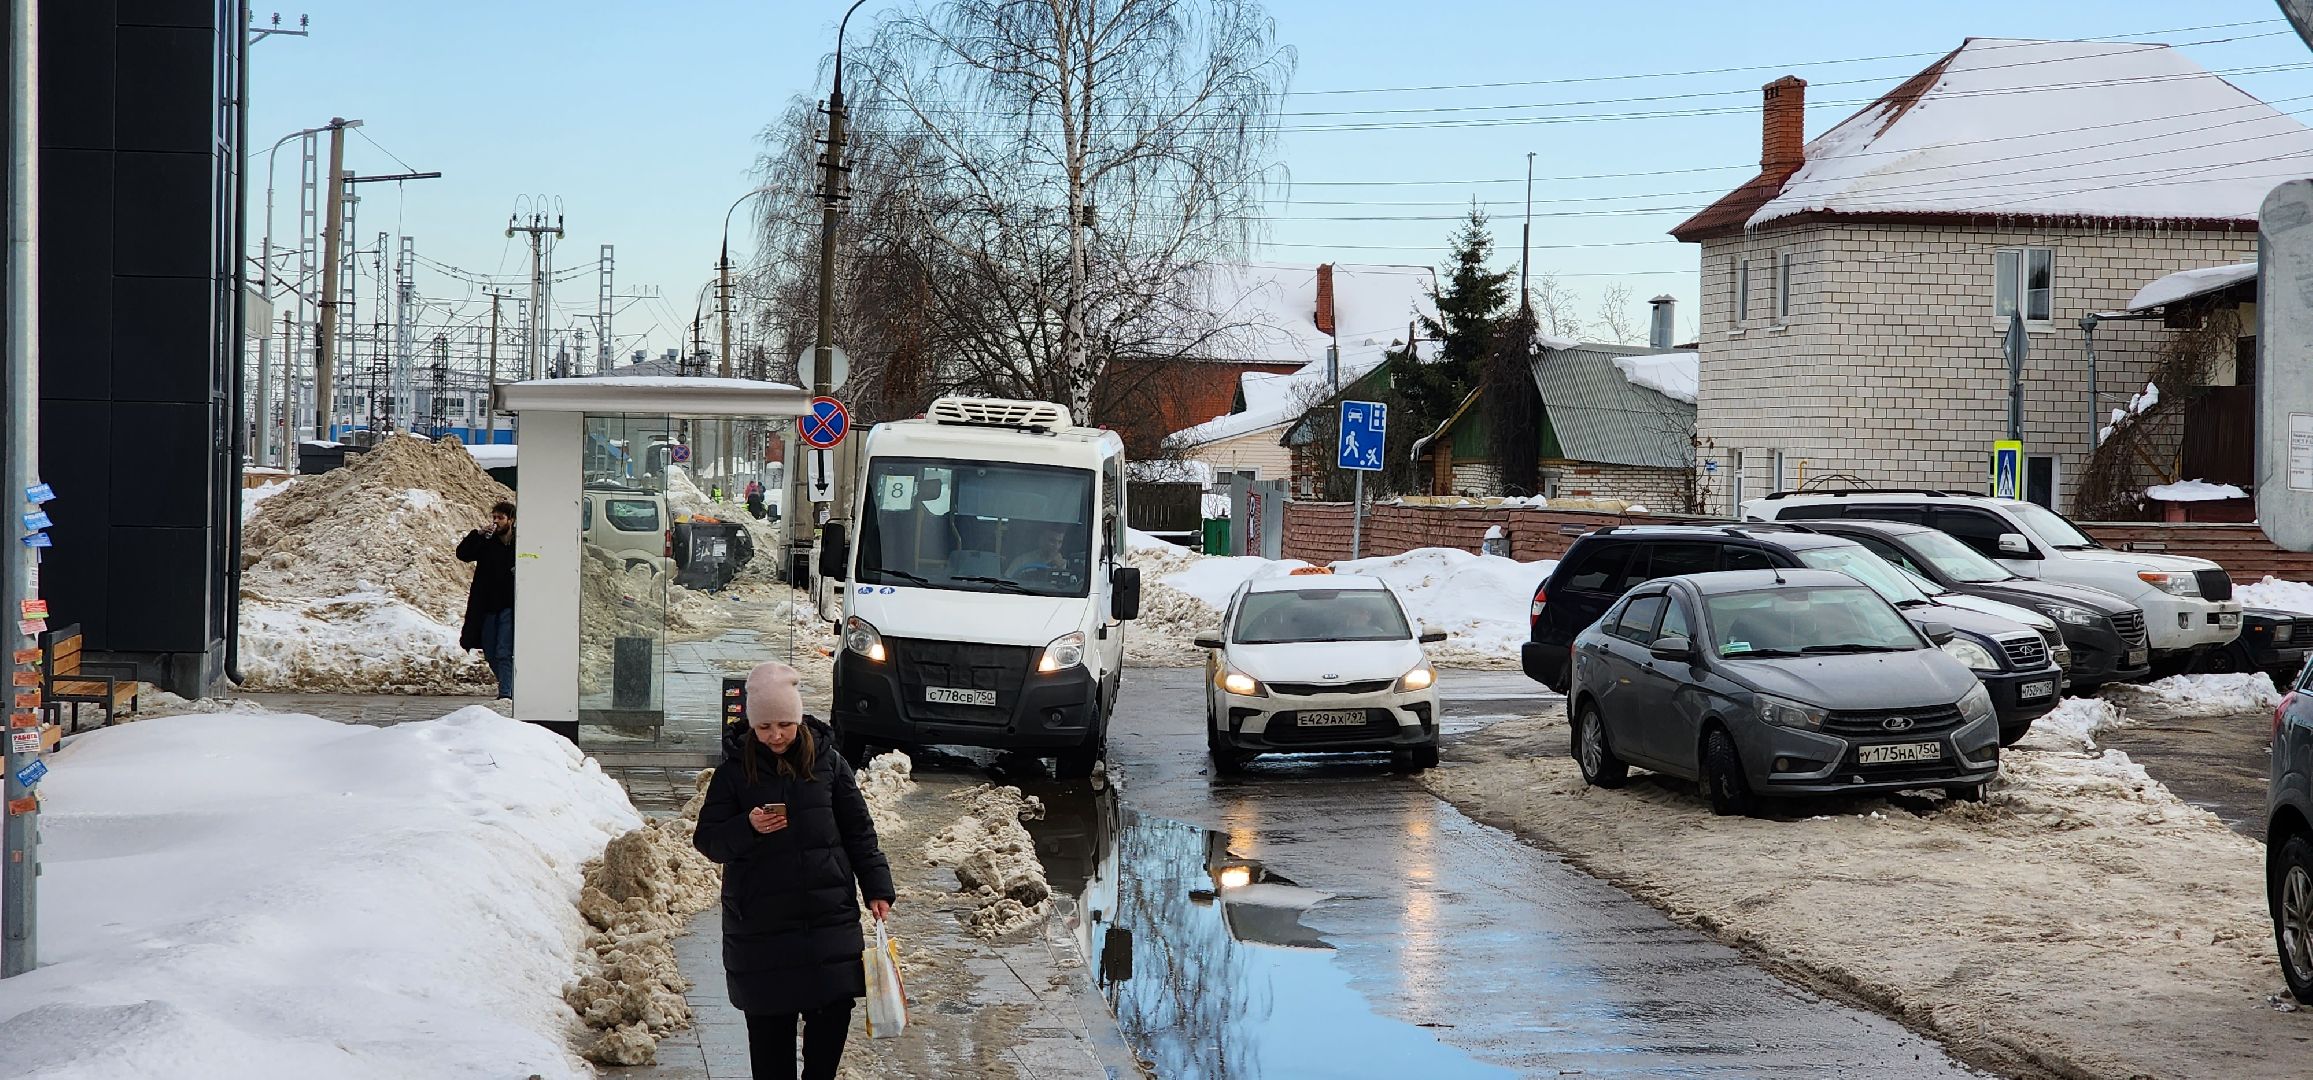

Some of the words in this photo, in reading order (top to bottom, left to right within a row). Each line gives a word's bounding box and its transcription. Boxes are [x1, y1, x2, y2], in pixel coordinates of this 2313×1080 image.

[891, 482, 903, 498] 8
[929, 689, 973, 703] С778СВ
[976, 691, 993, 701] 750
[1300, 713, 1344, 725] Е429АХ
[1346, 712, 1363, 721] 797
[1864, 745, 1916, 762] У175НА
[1916, 743, 1936, 755] 750
